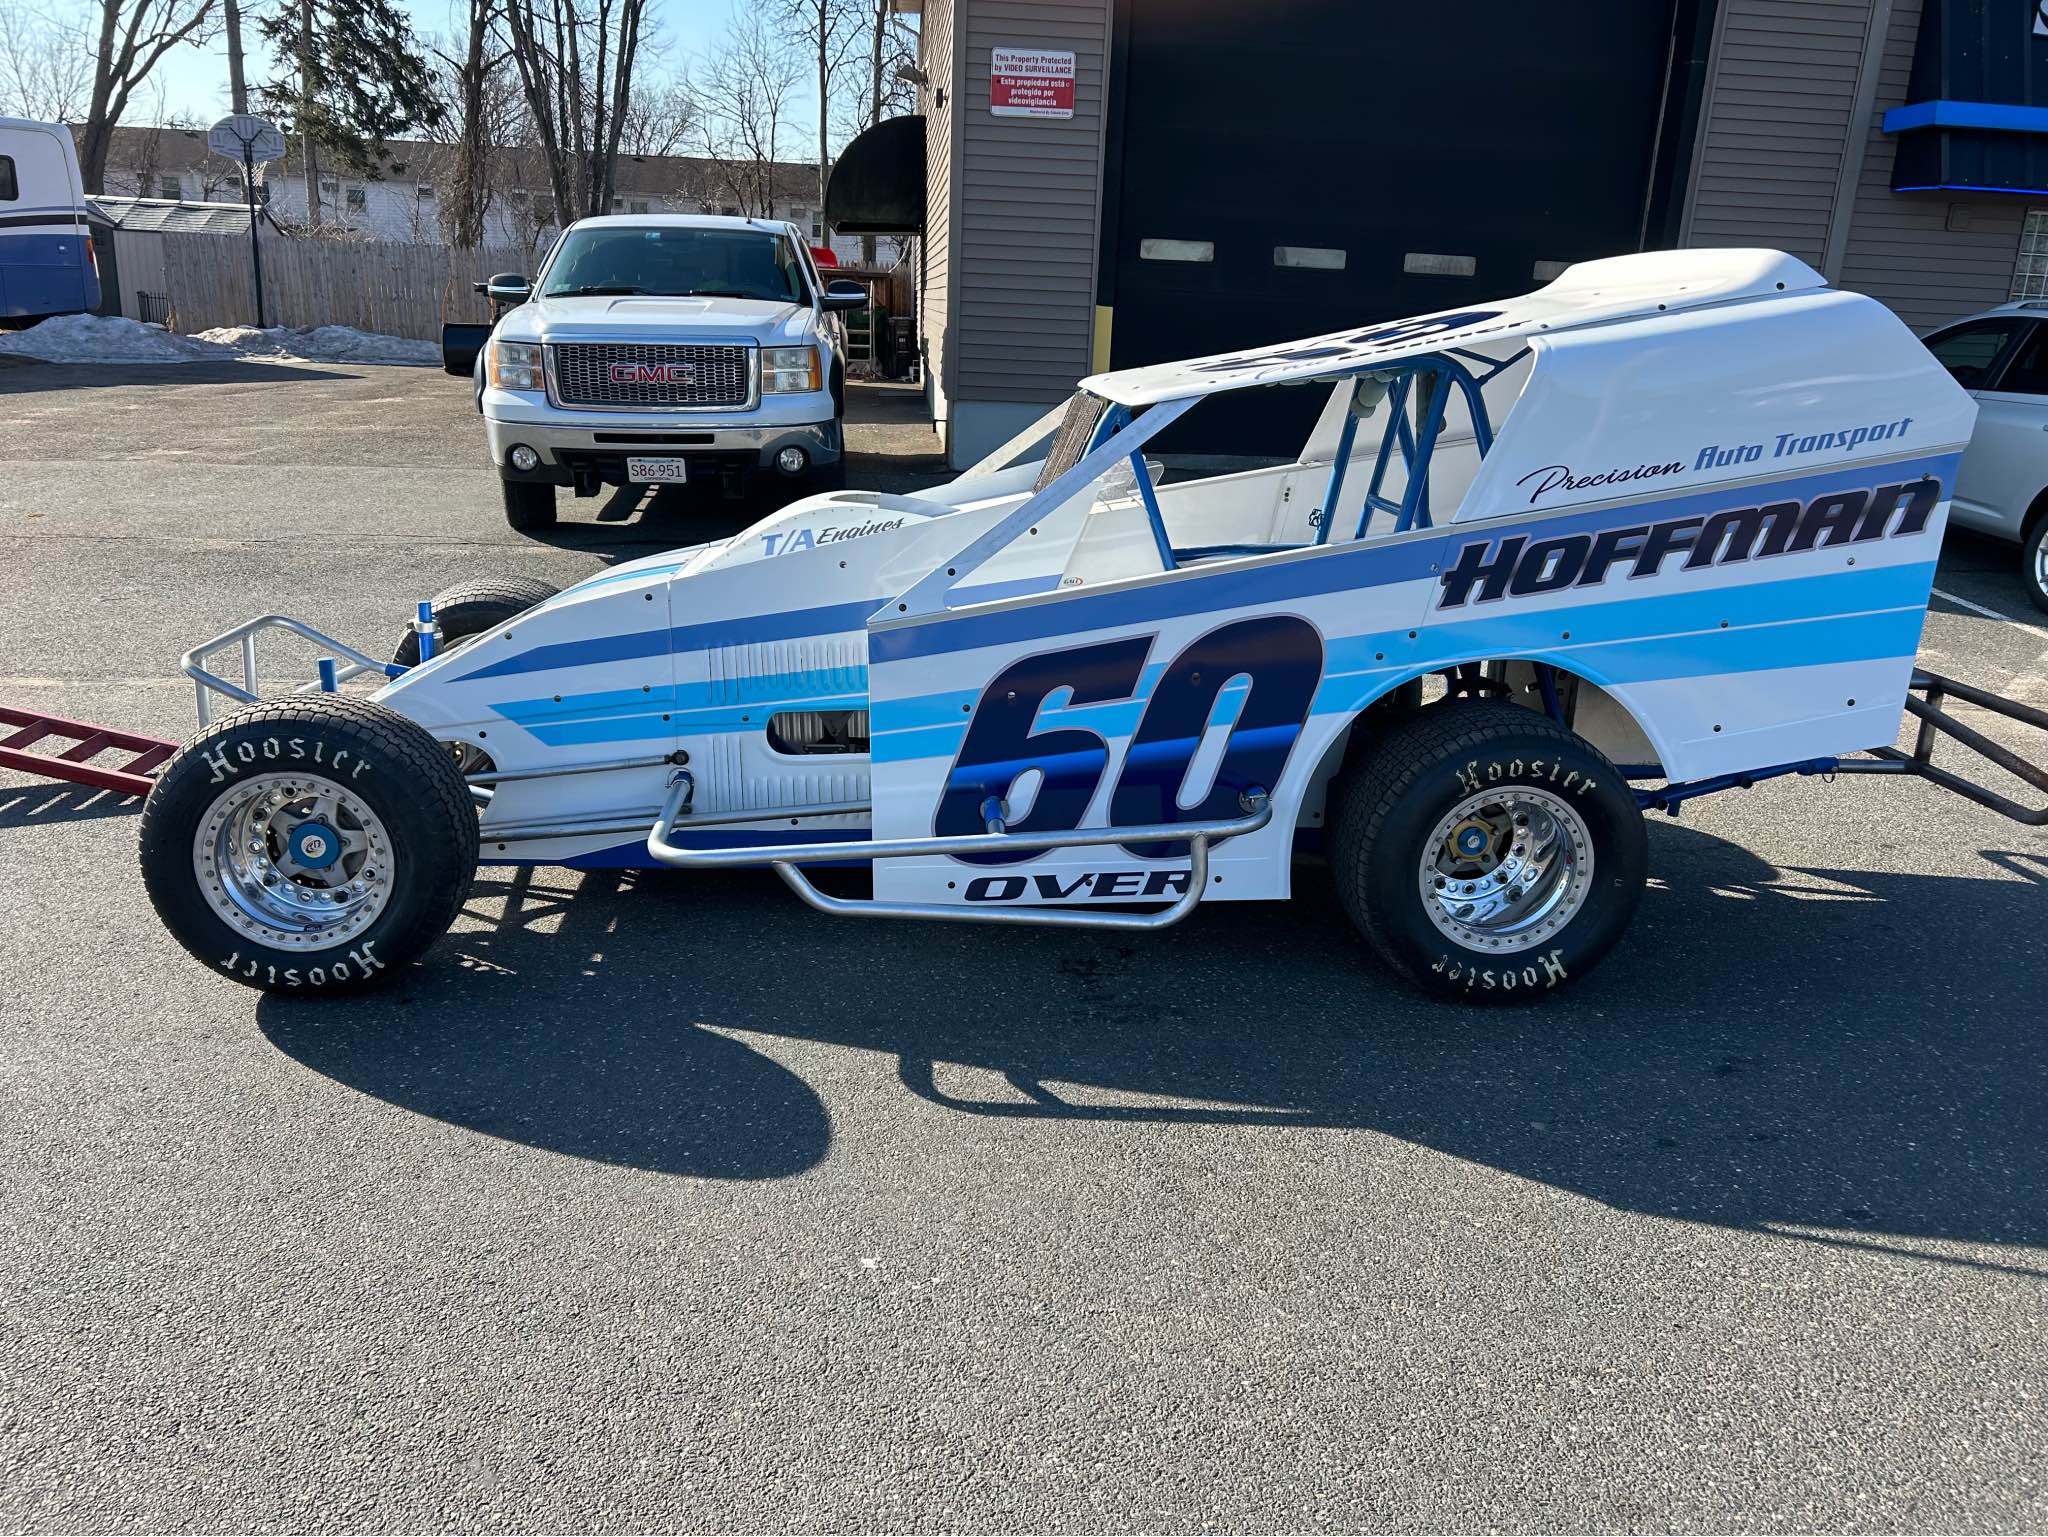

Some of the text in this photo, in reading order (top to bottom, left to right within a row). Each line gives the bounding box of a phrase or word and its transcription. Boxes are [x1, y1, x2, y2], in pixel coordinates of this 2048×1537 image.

[994, 64, 1072, 74] by VIDEO SURVEILLANCE
[1011, 55, 1039, 64] Property
[1041, 56, 1072, 65] Protected
[1001, 77, 1015, 85] Esta
[1016, 79, 1049, 87] propiedad
[1010, 88, 1055, 98] protegido por
[1008, 98, 1057, 106] videovigilancia
[610, 363, 693, 384] GMC
[1516, 417, 1915, 504] Precision Auto Transport
[761, 517, 905, 556] T/A Engines
[1436, 476, 1942, 609] HOFFMAN
[932, 612, 1326, 868] 60
[201, 737, 372, 784] Hoosier
[1455, 756, 1597, 798] Hoosier
[963, 869, 1196, 902] OVER
[220, 940, 386, 987] Hoosier
[1431, 948, 1569, 993] Hoosier
